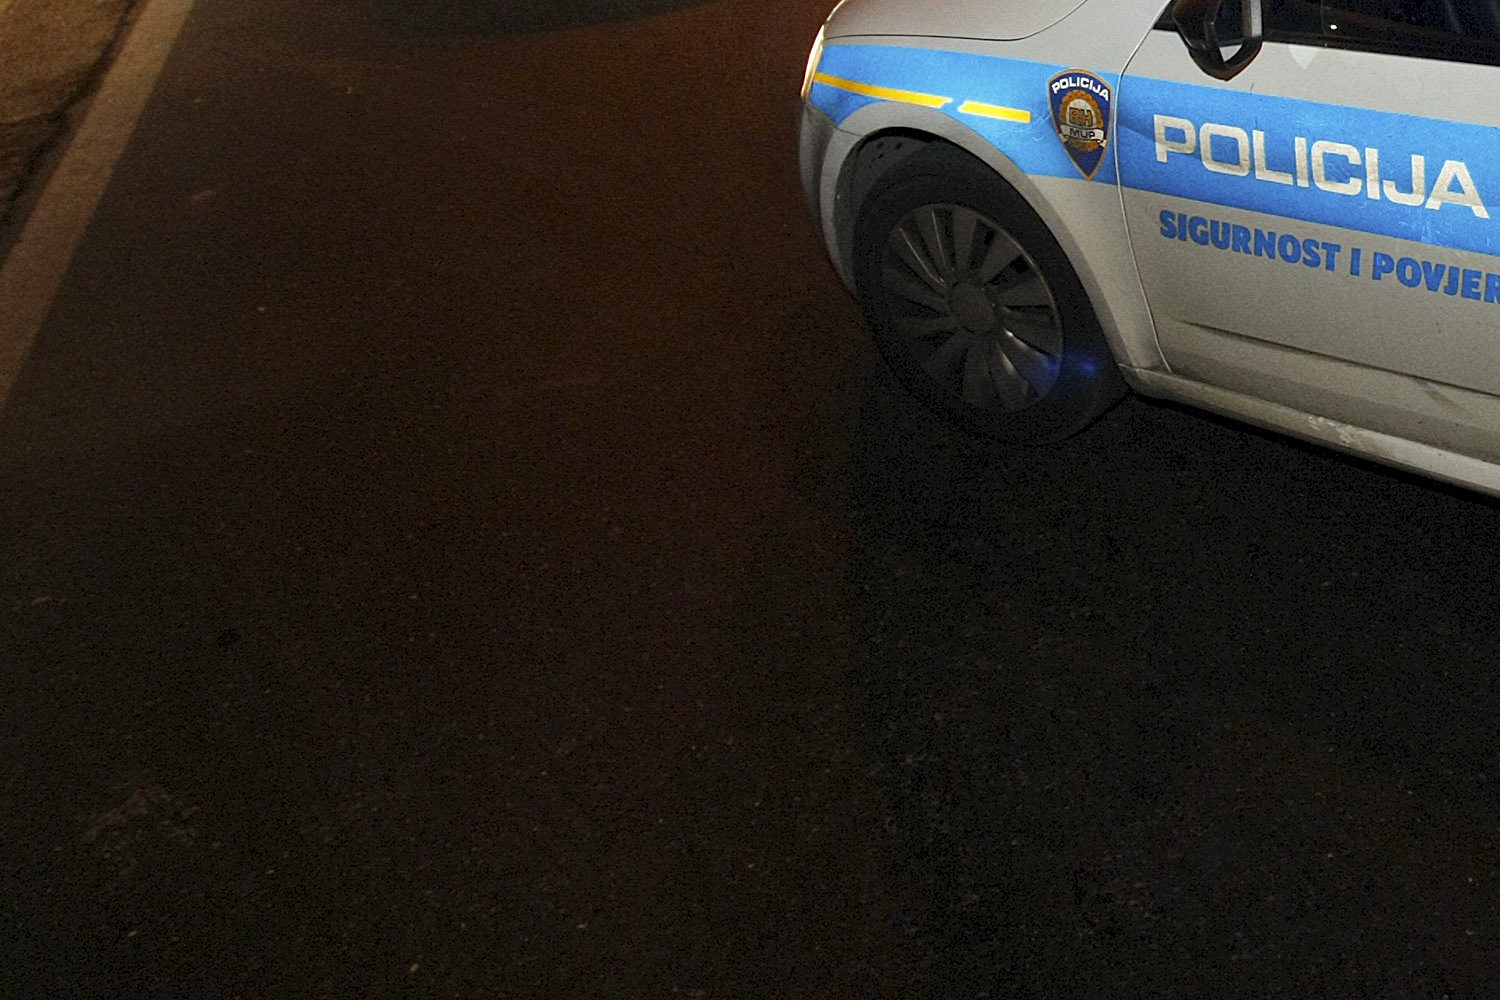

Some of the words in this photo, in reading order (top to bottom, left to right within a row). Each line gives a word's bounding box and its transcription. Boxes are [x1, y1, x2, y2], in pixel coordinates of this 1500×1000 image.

[1052, 77, 1109, 101] POLICIJA
[1069, 127, 1096, 139] MUP
[1153, 114, 1491, 219] POLICIJA
[1159, 210, 1341, 271] SIGURNOST
[1350, 248, 1361, 277] I
